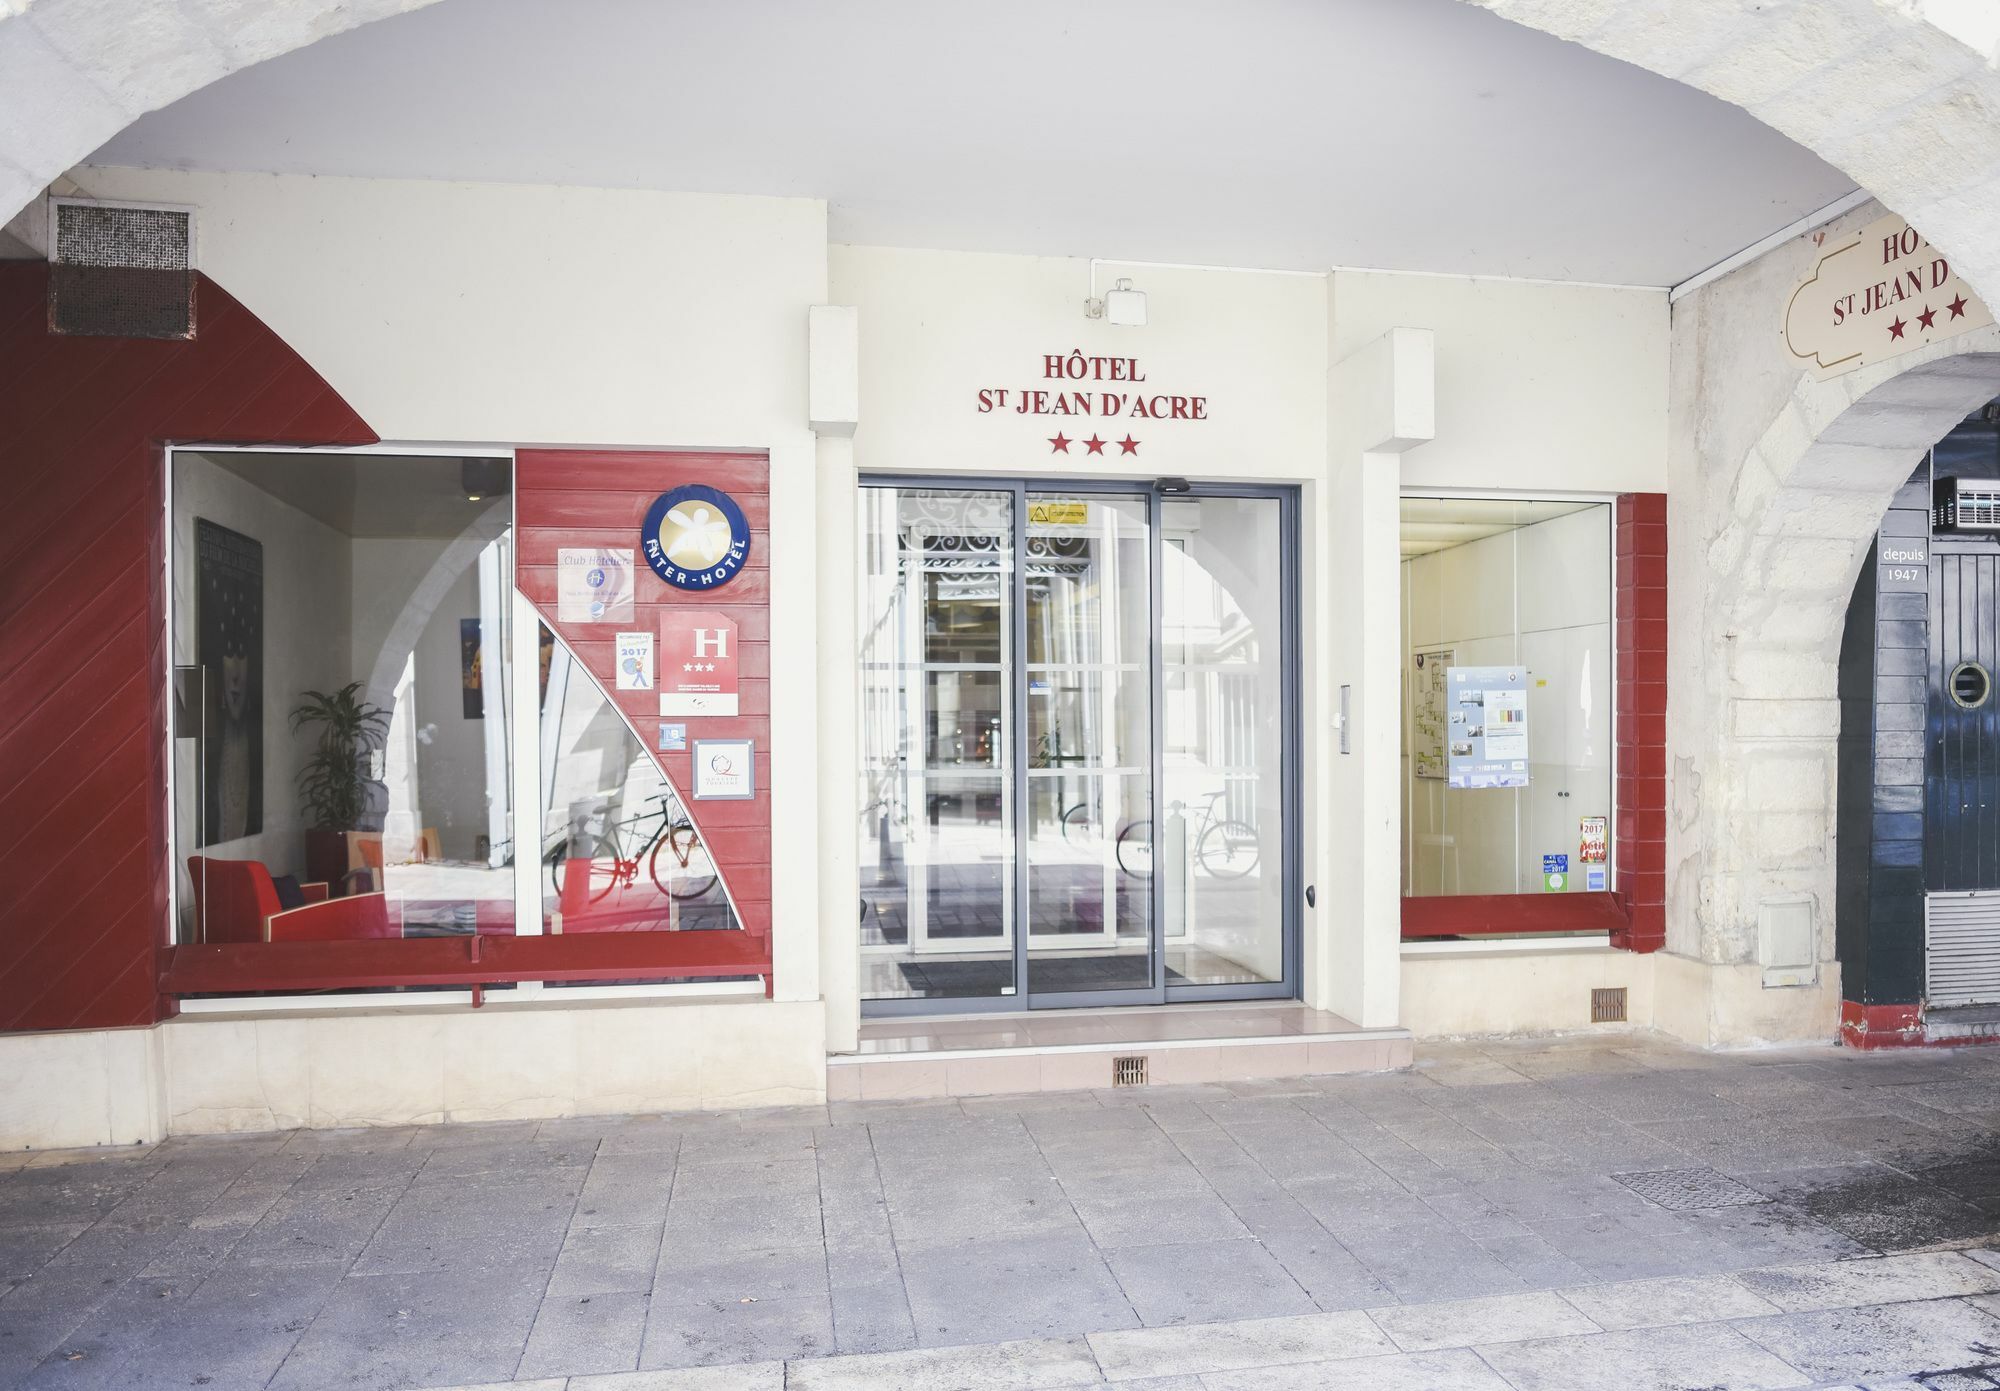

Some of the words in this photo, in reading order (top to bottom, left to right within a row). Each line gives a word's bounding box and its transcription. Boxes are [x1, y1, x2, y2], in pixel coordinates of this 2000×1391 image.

[1882, 222, 1931, 265] HÔ
[1861, 266, 1923, 316] JEAN
[1043, 348, 1146, 383] HÔTEL
[1016, 390, 1092, 416] JEAN
[1100, 392, 1208, 421] D'ACRE
[564, 555, 586, 566] Club
[646, 538, 746, 586] INTER-HOTEL
[1883, 547, 1924, 564] depuis
[1888, 569, 1918, 581] 1947
[621, 648, 648, 656] 2017
[693, 628, 731, 658] H
[1584, 825, 1604, 834] 2017
